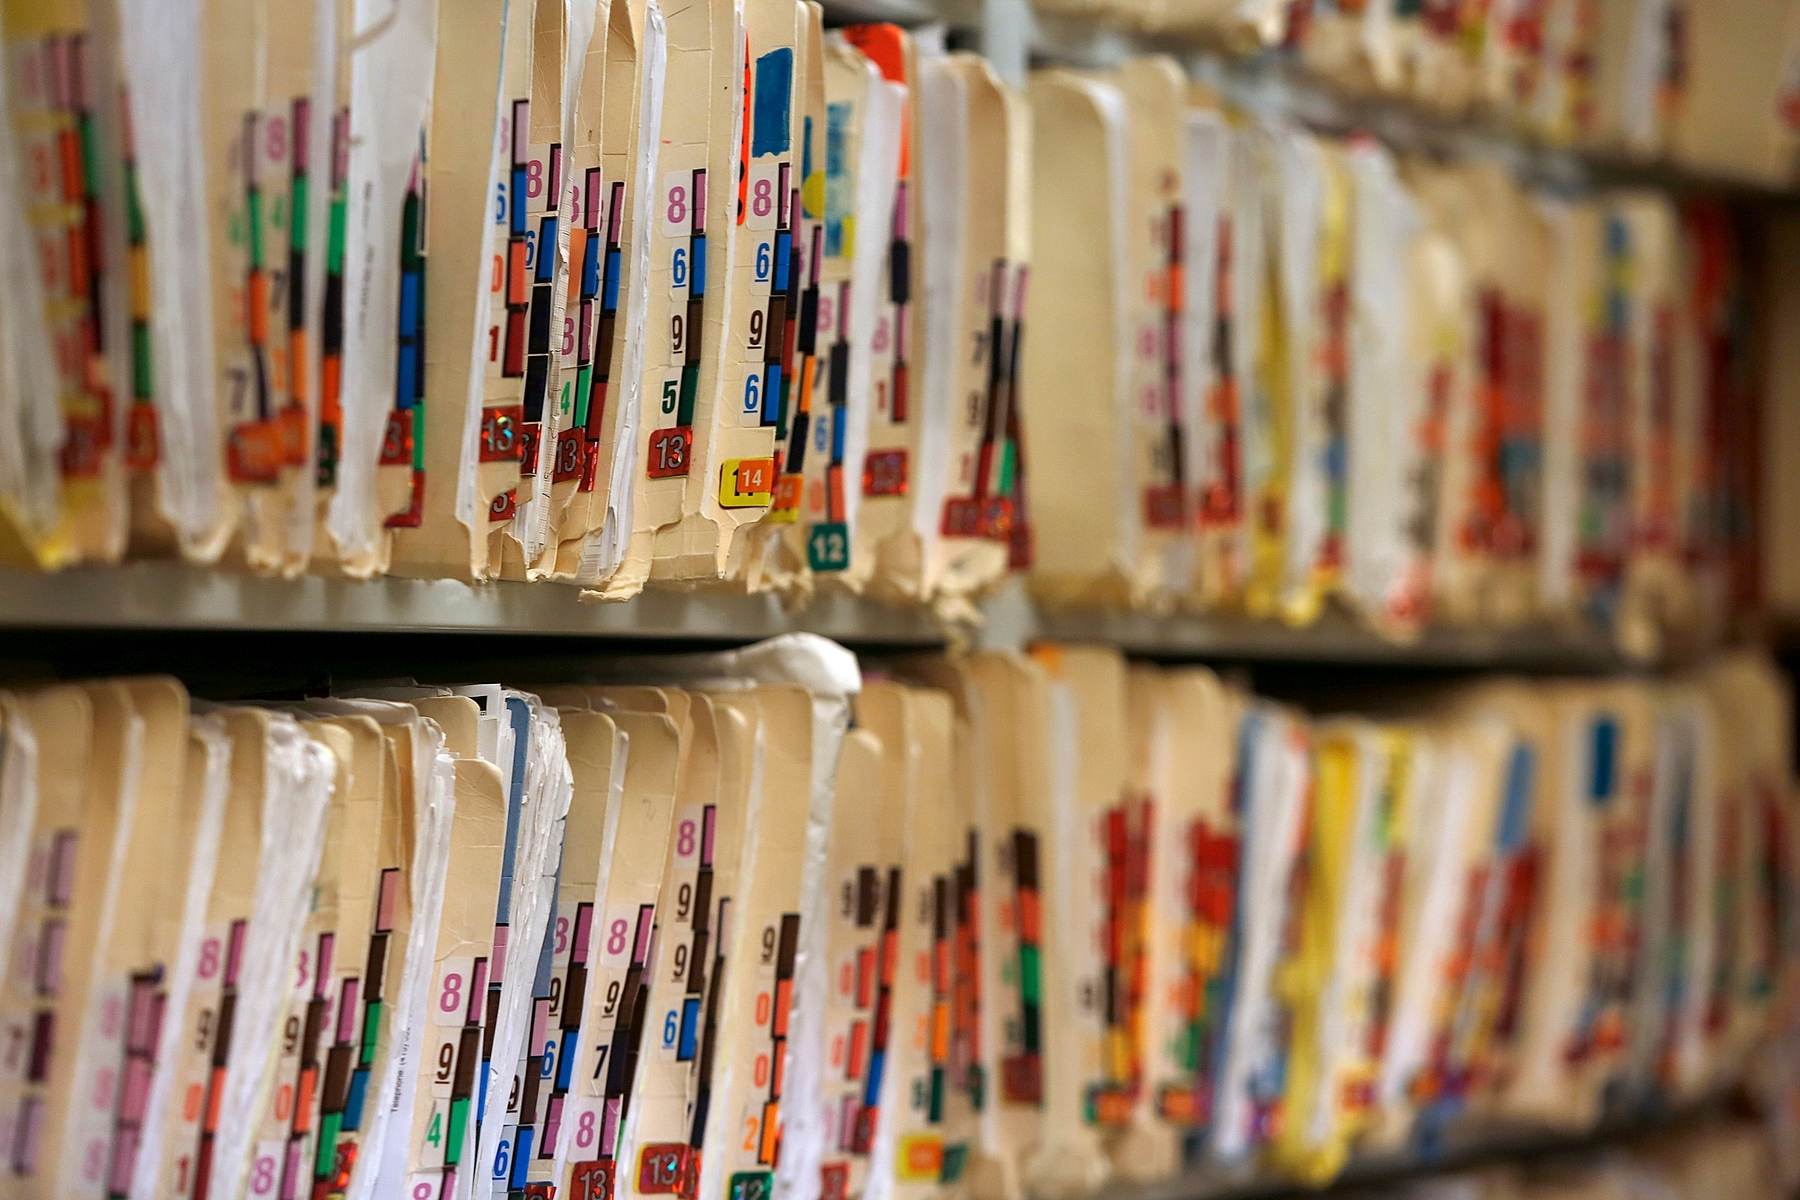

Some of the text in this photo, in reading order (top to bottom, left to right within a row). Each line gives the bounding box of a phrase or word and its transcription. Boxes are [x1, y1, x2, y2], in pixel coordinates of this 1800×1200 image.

[266, 116, 287, 162] 8
[526, 160, 543, 198] 8
[753, 179, 771, 217] 8
[755, 242, 770, 283] 6
[489, 325, 499, 362] 1
[656, 186, 687, 470] 8 6 9 5 13
[747, 309, 763, 349] 9
[561, 381, 571, 415] 4
[743, 374, 759, 413] 6
[481, 416, 514, 453] 13
[557, 438, 577, 474] 13
[742, 469, 762, 487] 14
[814, 534, 844, 562] 12
[198, 938, 221, 979] 8
[549, 977, 561, 1017] 9
[648, 820, 695, 1186] 8 9 9 6 13
[756, 992, 770, 1027] 0
[426, 973, 463, 1148] 8 9 4
[539, 1040, 556, 1080] 6
[576, 919, 628, 1200] 8 9 7 8 13
[754, 1054, 768, 1088] 0
[274, 1084, 293, 1122] 0
[743, 1116, 759, 1151] 2
[178, 1156, 190, 1194] 1
[252, 1156, 276, 1194] 8
[492, 1139, 510, 1180] 6
